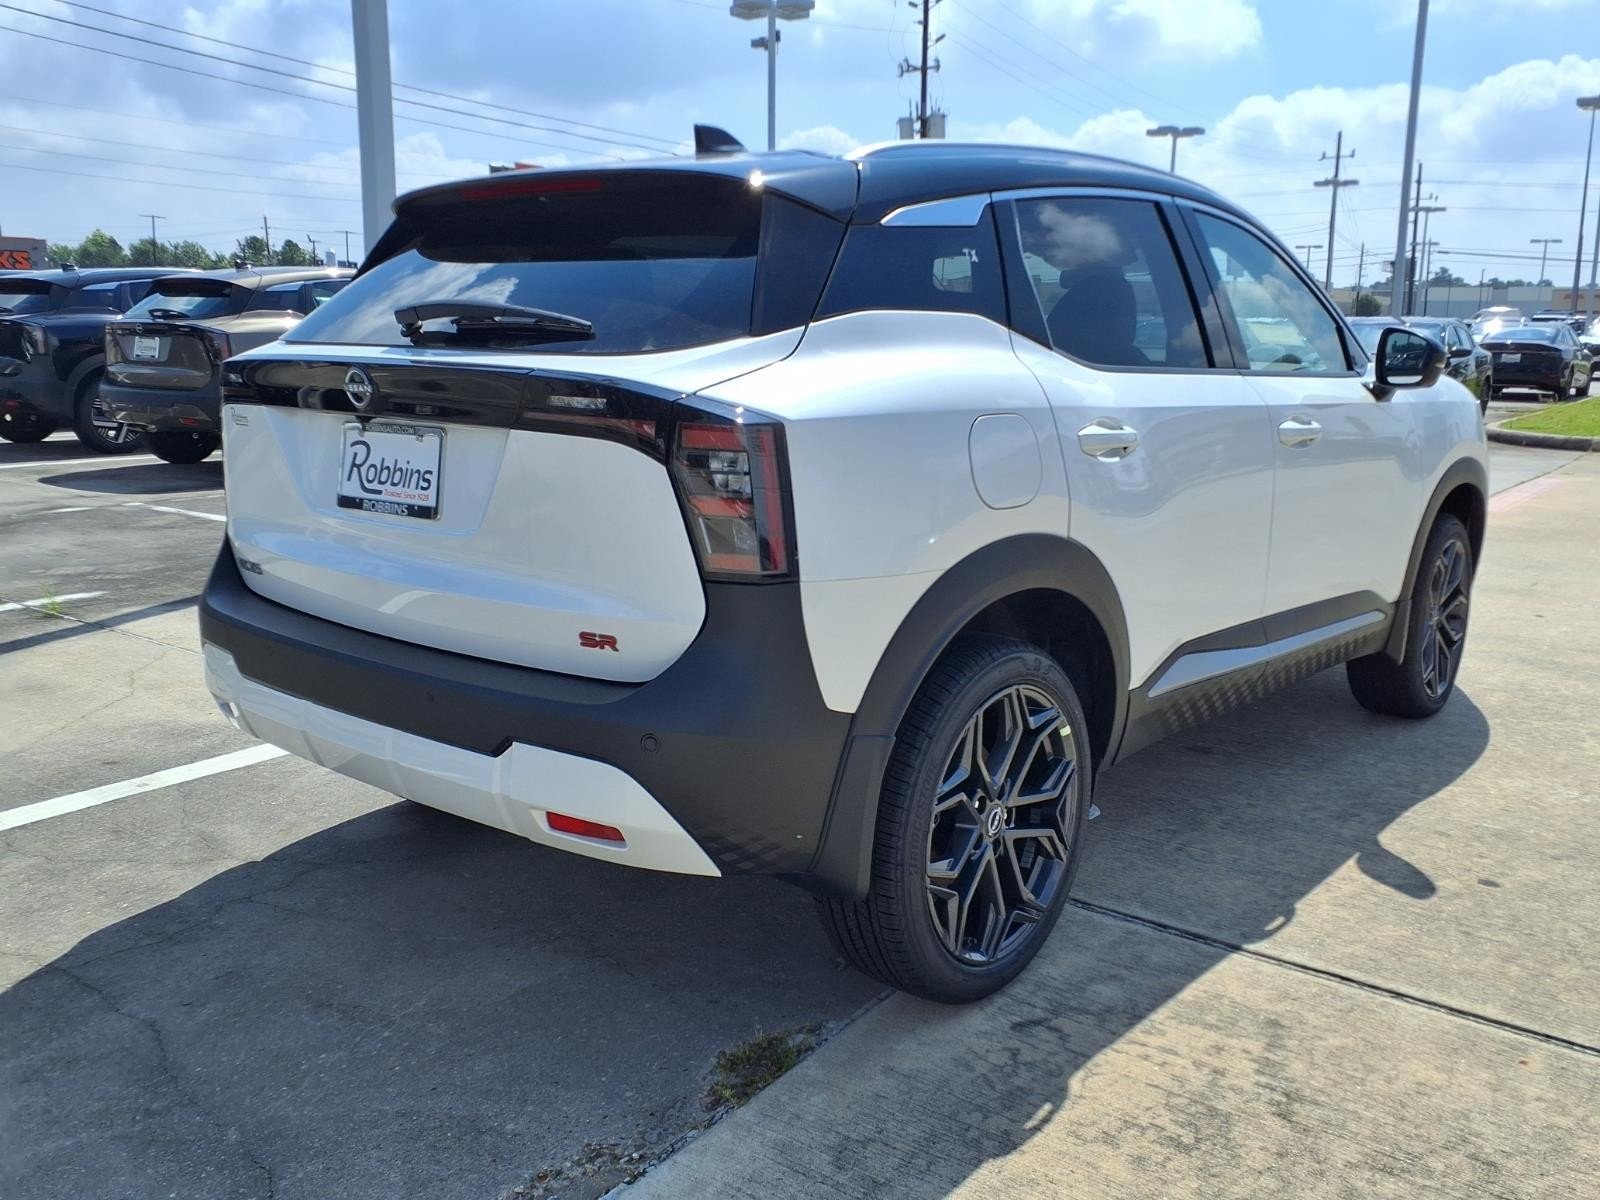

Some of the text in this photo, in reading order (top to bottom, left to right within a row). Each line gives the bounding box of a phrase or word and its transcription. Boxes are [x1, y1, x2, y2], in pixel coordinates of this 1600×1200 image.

[346, 439, 433, 496] Robbins
[362, 500, 409, 516] ROBBINS
[579, 631, 620, 652] SR
